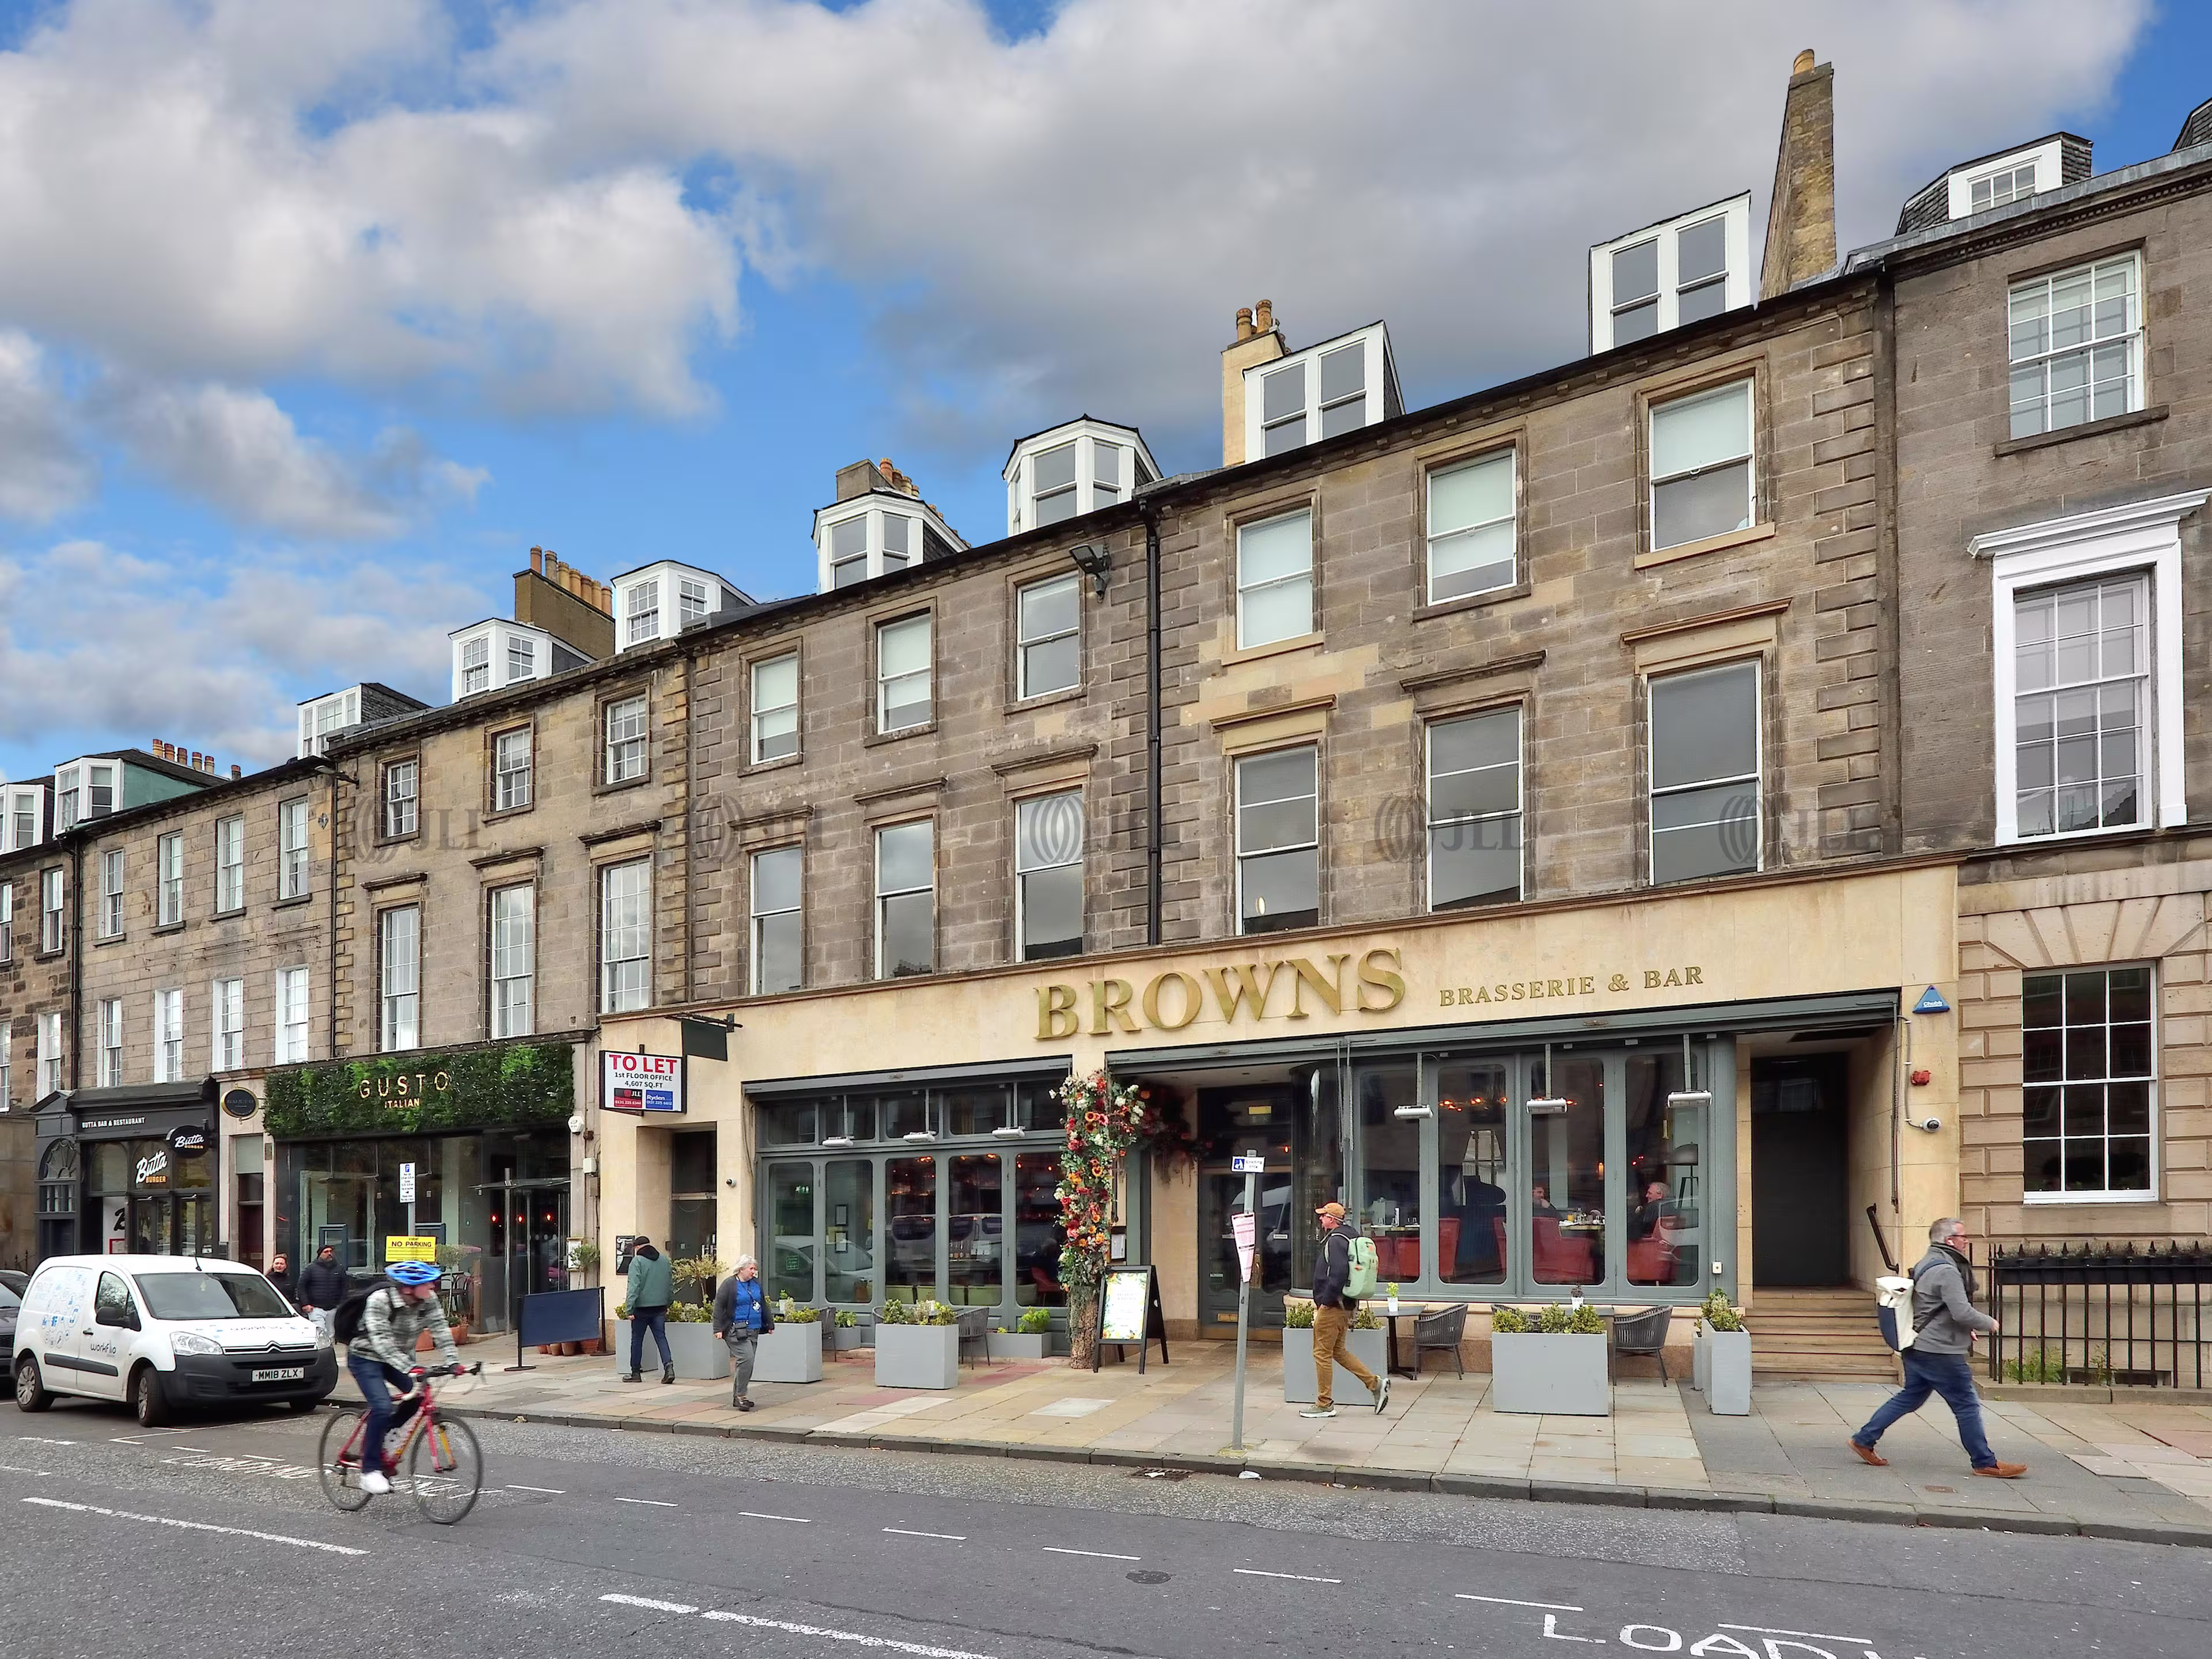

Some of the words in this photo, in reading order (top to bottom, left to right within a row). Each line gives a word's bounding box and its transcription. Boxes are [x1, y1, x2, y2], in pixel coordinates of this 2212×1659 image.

[1033, 947, 1406, 1039] BROWNS
[1440, 976, 1595, 1006] BRASSERIE
[1608, 973, 1630, 992] &
[1644, 965, 1704, 988] BAR
[609, 1054, 637, 1071] TO
[643, 1057, 677, 1074] LET
[359, 1071, 449, 1099] GUSTO
[384, 1098, 421, 1109] ITALIAN
[113, 1117, 145, 1126] RESTAURANT
[175, 1134, 204, 1148] Butta
[136, 1150, 168, 1184] Butta
[281, 1369, 298, 1378] ZLX
[1543, 1613, 1927, 1659] LOAD
